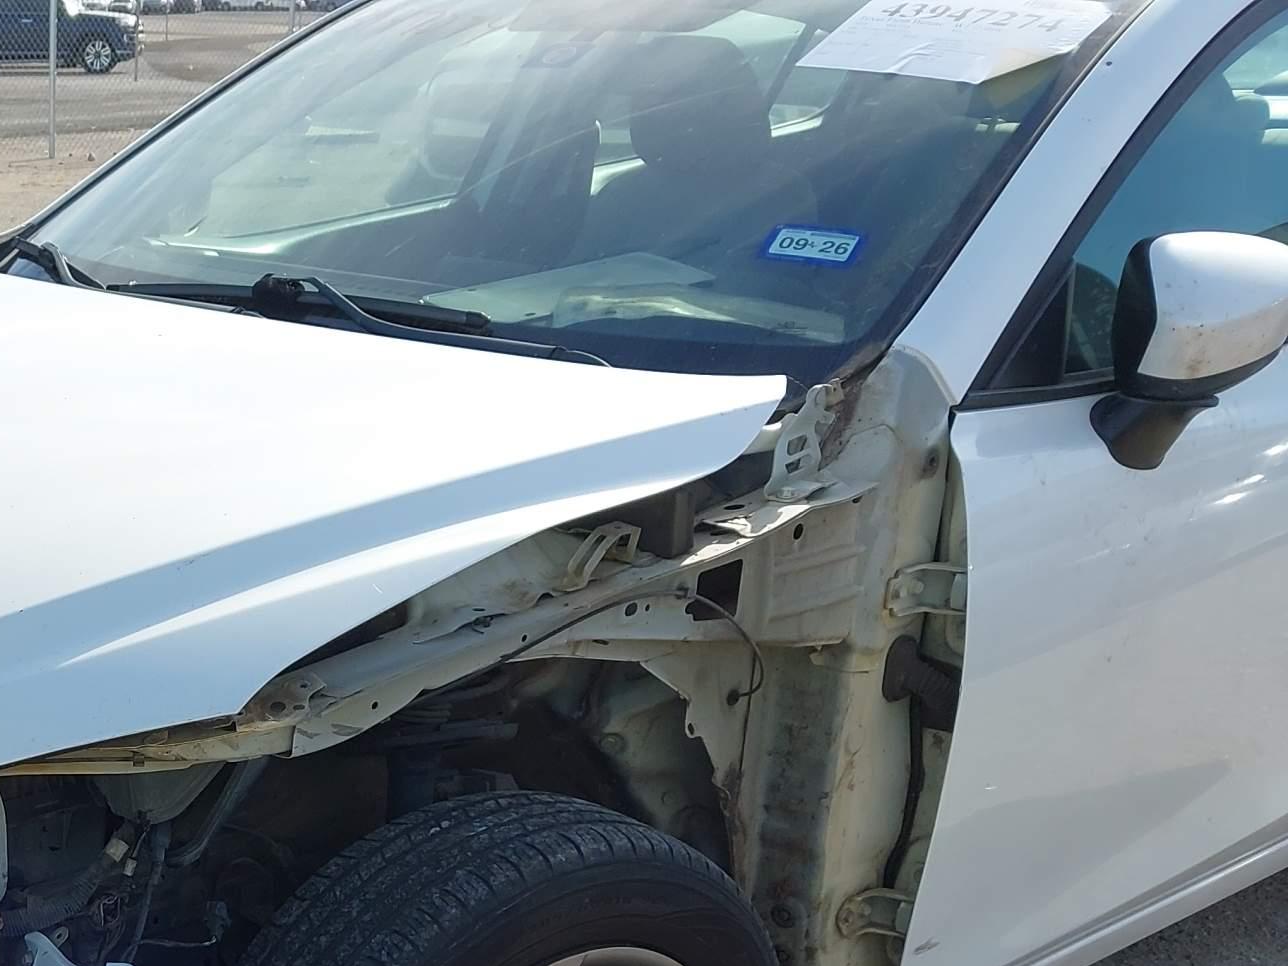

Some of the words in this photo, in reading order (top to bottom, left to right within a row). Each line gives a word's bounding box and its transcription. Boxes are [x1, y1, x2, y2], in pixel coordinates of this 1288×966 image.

[881, 2, 1065, 32] 43947274
[778, 236, 809, 250] 09
[818, 240, 850, 255] 26
